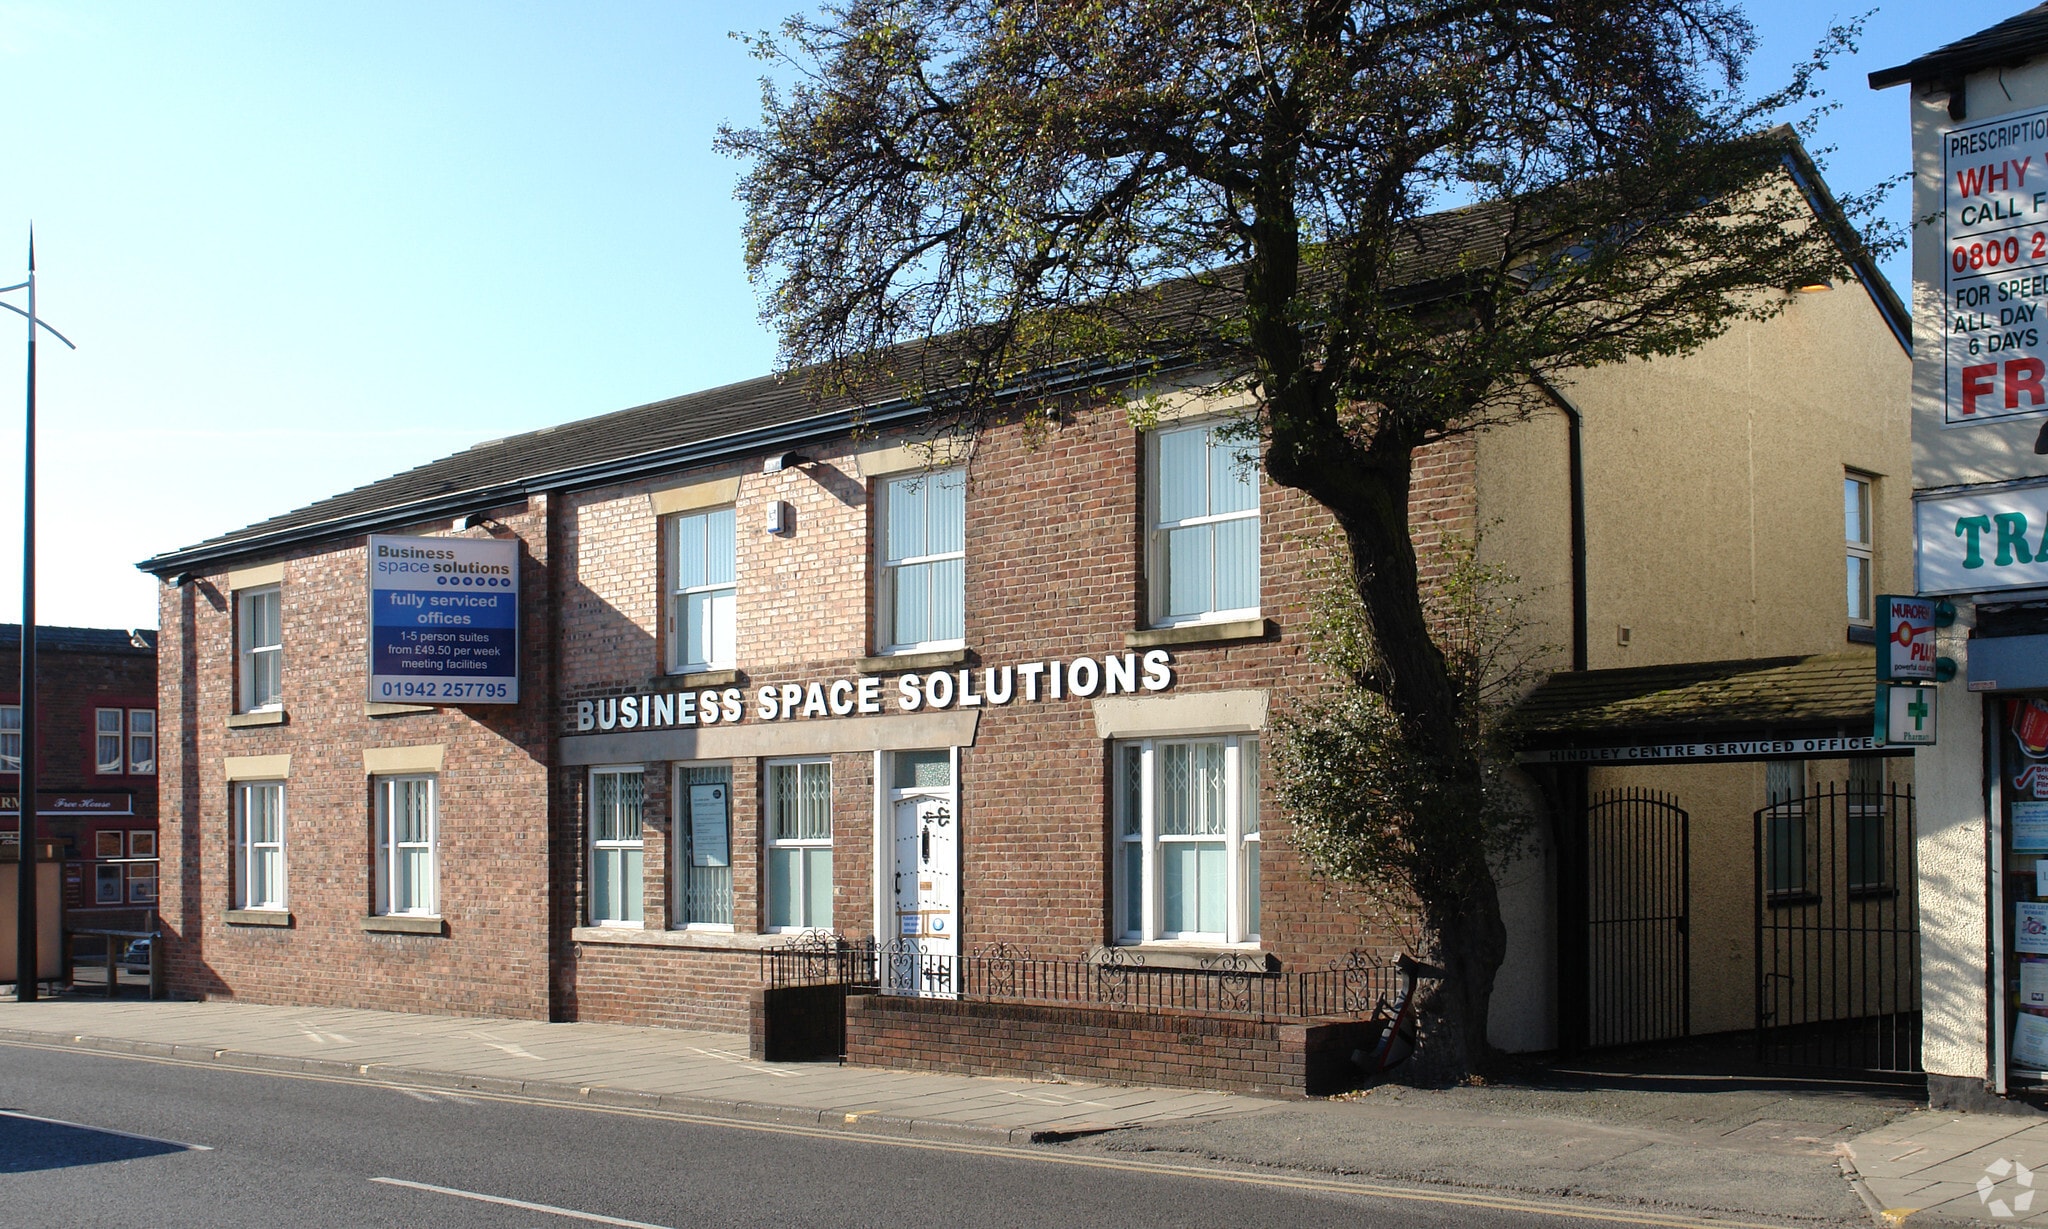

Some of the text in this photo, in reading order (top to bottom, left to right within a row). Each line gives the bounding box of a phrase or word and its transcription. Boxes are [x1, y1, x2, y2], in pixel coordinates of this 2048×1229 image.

[1951, 118, 2048, 158] PRESCRIPTIO
[1956, 156, 2032, 199] WHY
[1961, 198, 2022, 226] CALL
[1952, 231, 2046, 273] 0800 2
[1956, 285, 1990, 309] FOR
[1954, 303, 2038, 334] ALL DAY
[1969, 328, 2038, 355] 6 DAYS
[1961, 357, 2046, 416] FR
[378, 545, 455, 560] Business
[378, 561, 510, 575] space solutions
[390, 593, 498, 608] fully serviced
[417, 611, 473, 625] offices
[400, 631, 489, 643] 1-5 person suites
[388, 644, 501, 657] from £49.50 per week
[401, 659, 488, 671] meeting facilities
[382, 682, 507, 698] 01942 257795
[577, 648, 1173, 732] BUSINESS SPACE SOLUTIONS
[1550, 738, 1885, 761] HINDLEY CENTRE SERVICED OFFICE
[54, 798, 111, 808] Free House
